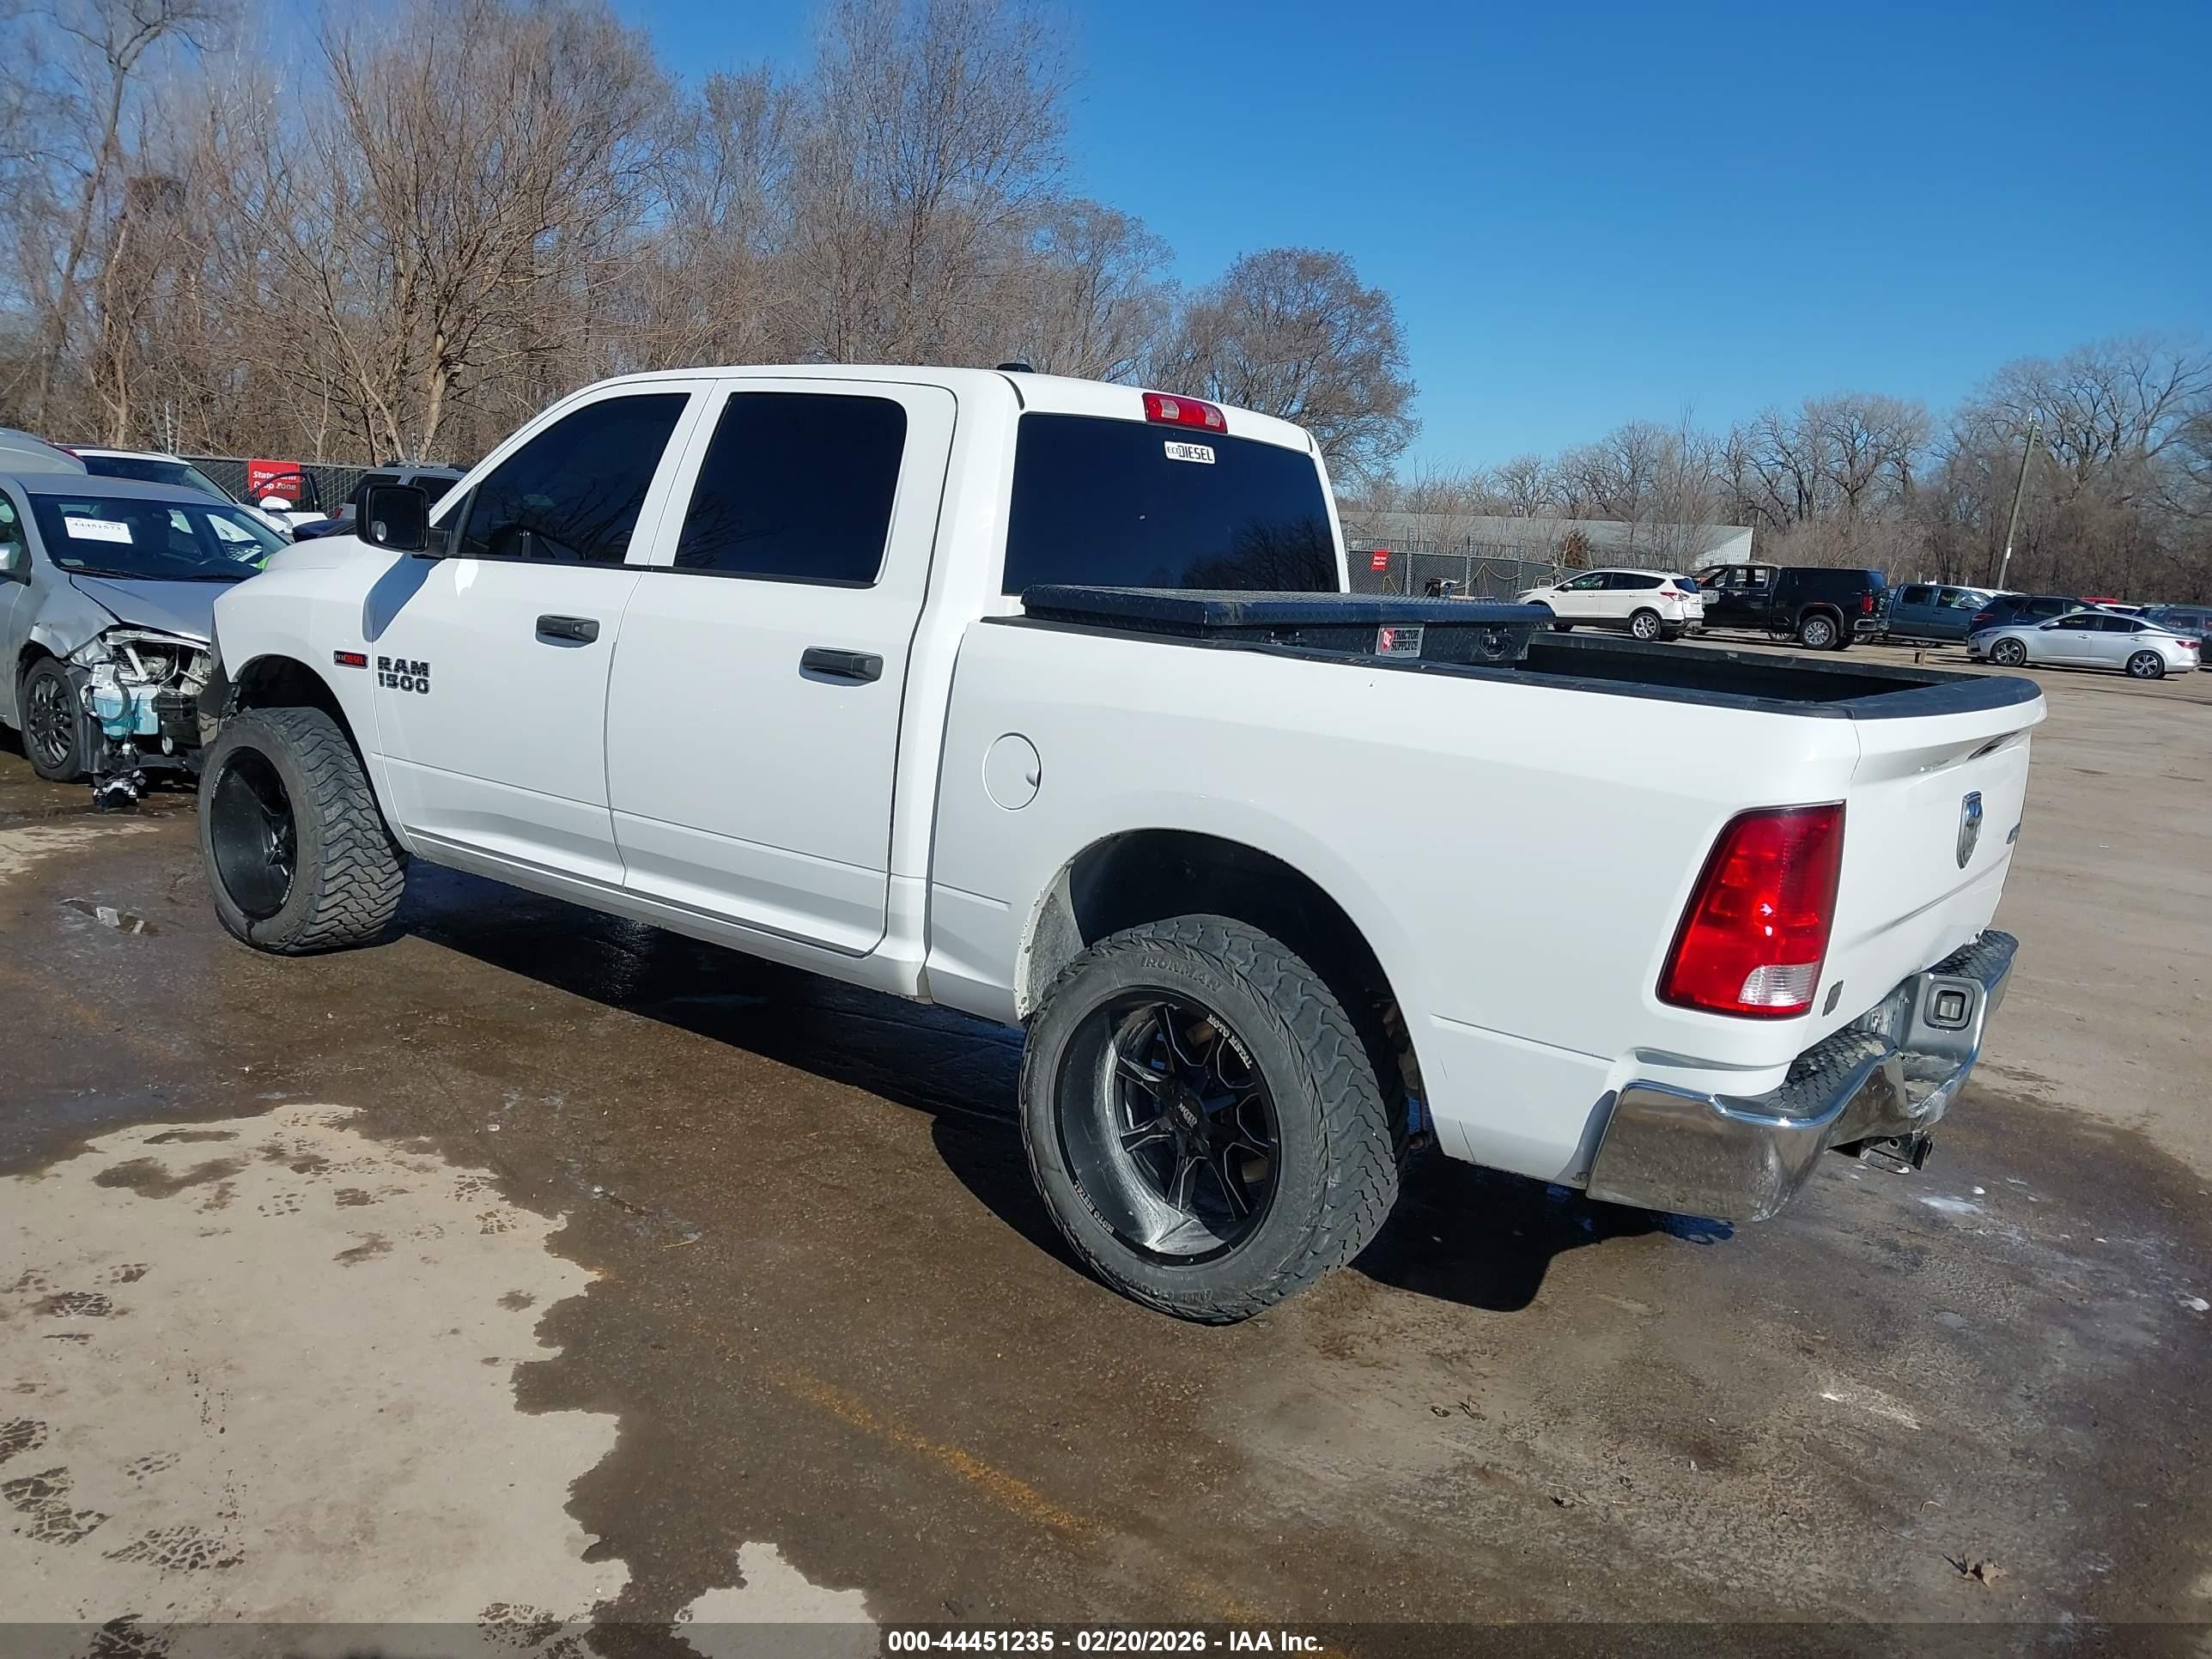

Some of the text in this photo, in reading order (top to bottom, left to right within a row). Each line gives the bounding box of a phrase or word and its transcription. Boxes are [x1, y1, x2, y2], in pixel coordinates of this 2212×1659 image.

[1166, 445, 1213, 461] ECODIESEL
[253, 481, 275, 490] Dop
[1394, 629, 1419, 640] TRACTOR
[377, 655, 431, 678] RAM
[377, 672, 430, 695] 1500
[1206, 1013, 1230, 1037] MOTO
